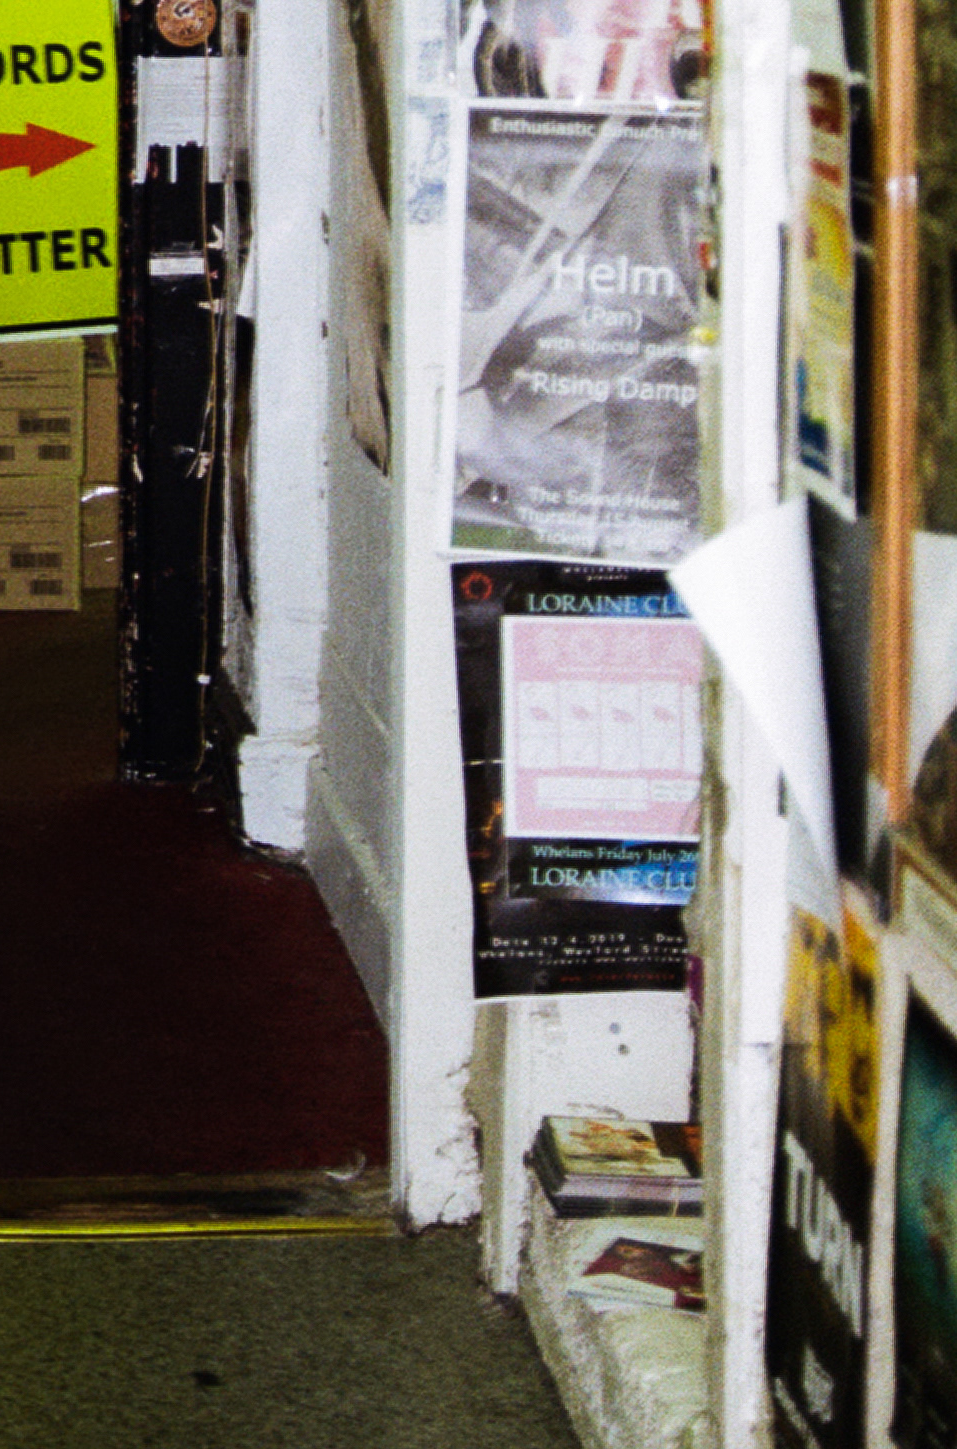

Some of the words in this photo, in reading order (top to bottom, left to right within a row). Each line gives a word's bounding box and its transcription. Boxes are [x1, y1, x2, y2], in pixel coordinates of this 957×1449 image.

[554, 252, 675, 297] Helm
[530, 371, 611, 402] Rising
[618, 377, 699, 409] Damp
[527, 593, 641, 614] LORAINE
[597, 845, 643, 864] Friday
[646, 848, 675, 867] July
[531, 866, 641, 887] LORAINE
